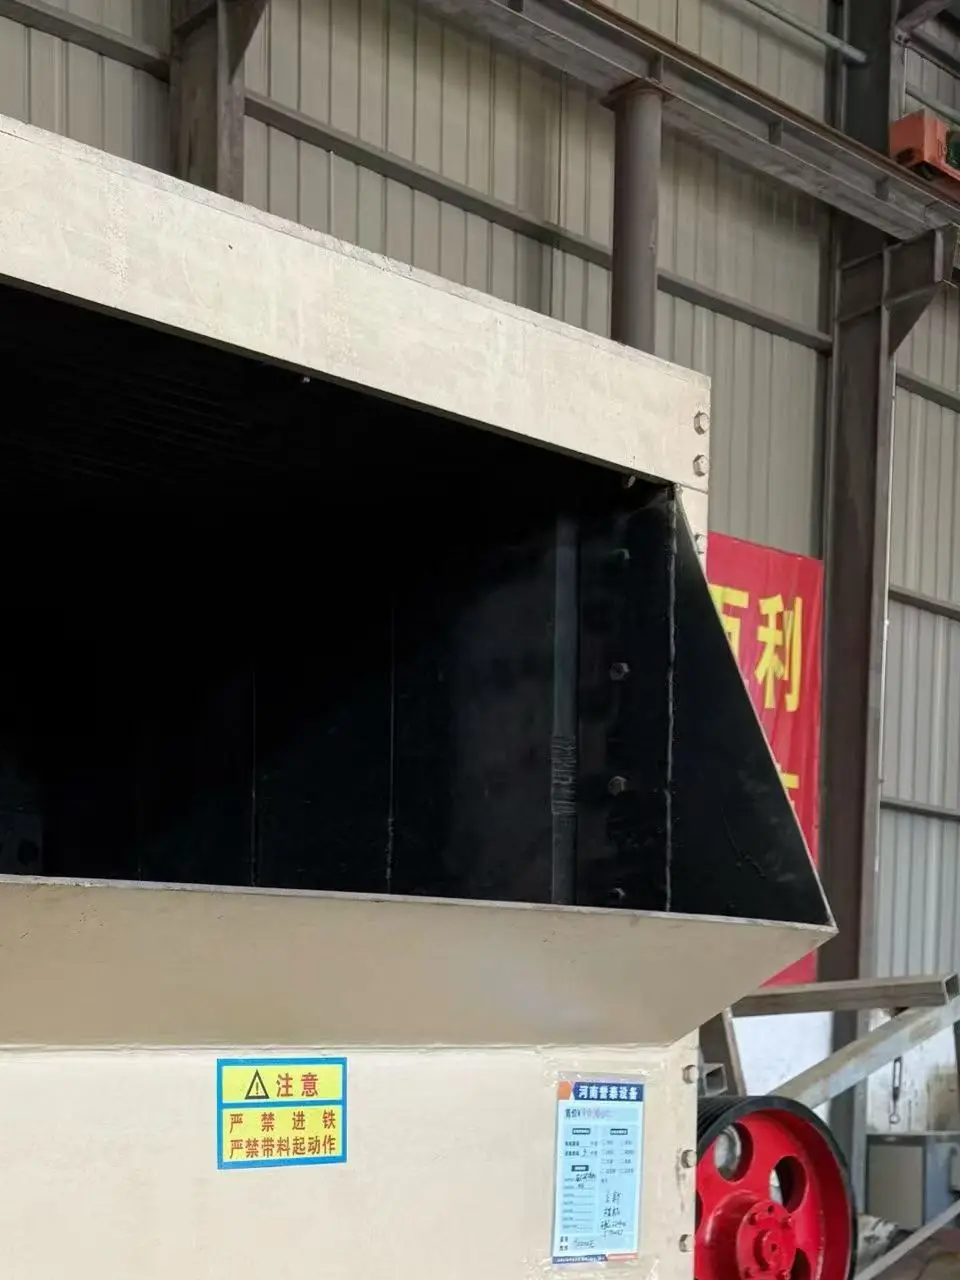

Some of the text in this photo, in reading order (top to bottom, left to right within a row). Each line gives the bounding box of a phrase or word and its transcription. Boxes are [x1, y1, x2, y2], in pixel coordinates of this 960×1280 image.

[276, 1072, 319, 1097] 注意
[229, 1109, 336, 1134] 严禁进铁
[229, 1135, 336, 1159] 严禁带料起动作
